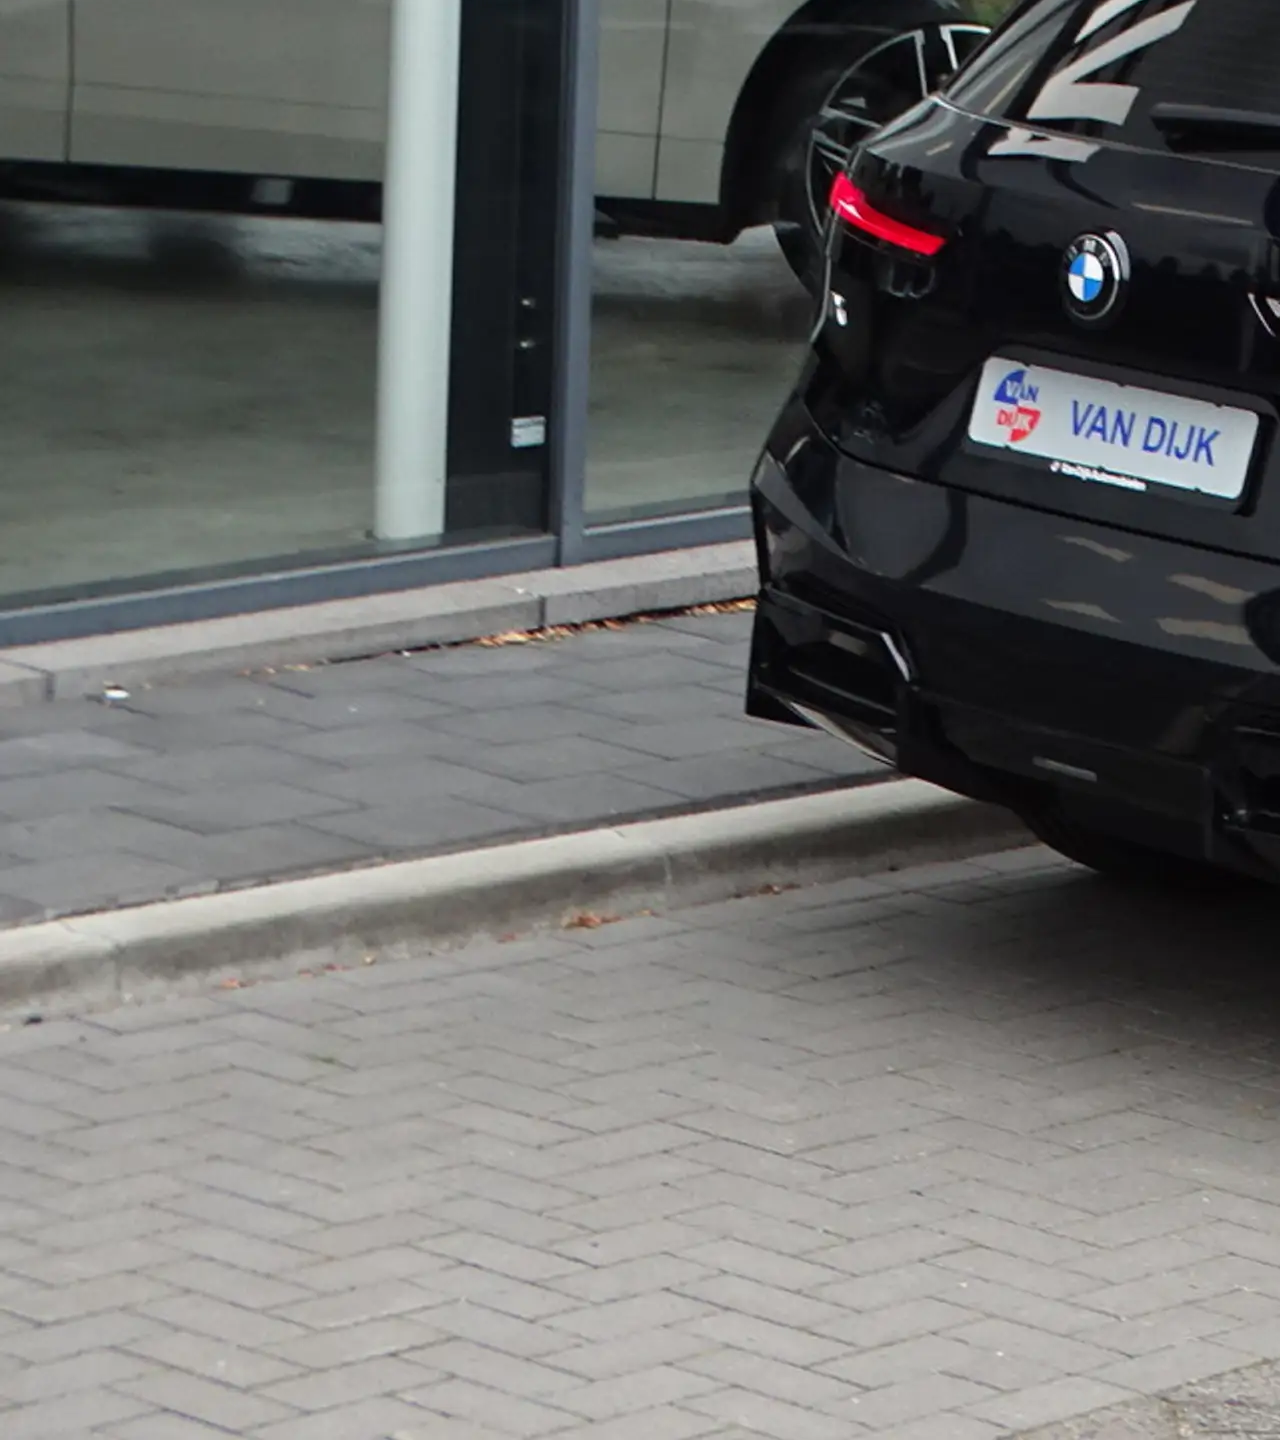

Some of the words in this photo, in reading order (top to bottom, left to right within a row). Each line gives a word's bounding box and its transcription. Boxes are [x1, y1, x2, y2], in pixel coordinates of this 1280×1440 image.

[1005, 379, 1039, 404] VAN
[1071, 399, 1136, 448] VAN
[1142, 415, 1222, 467] DIJK
